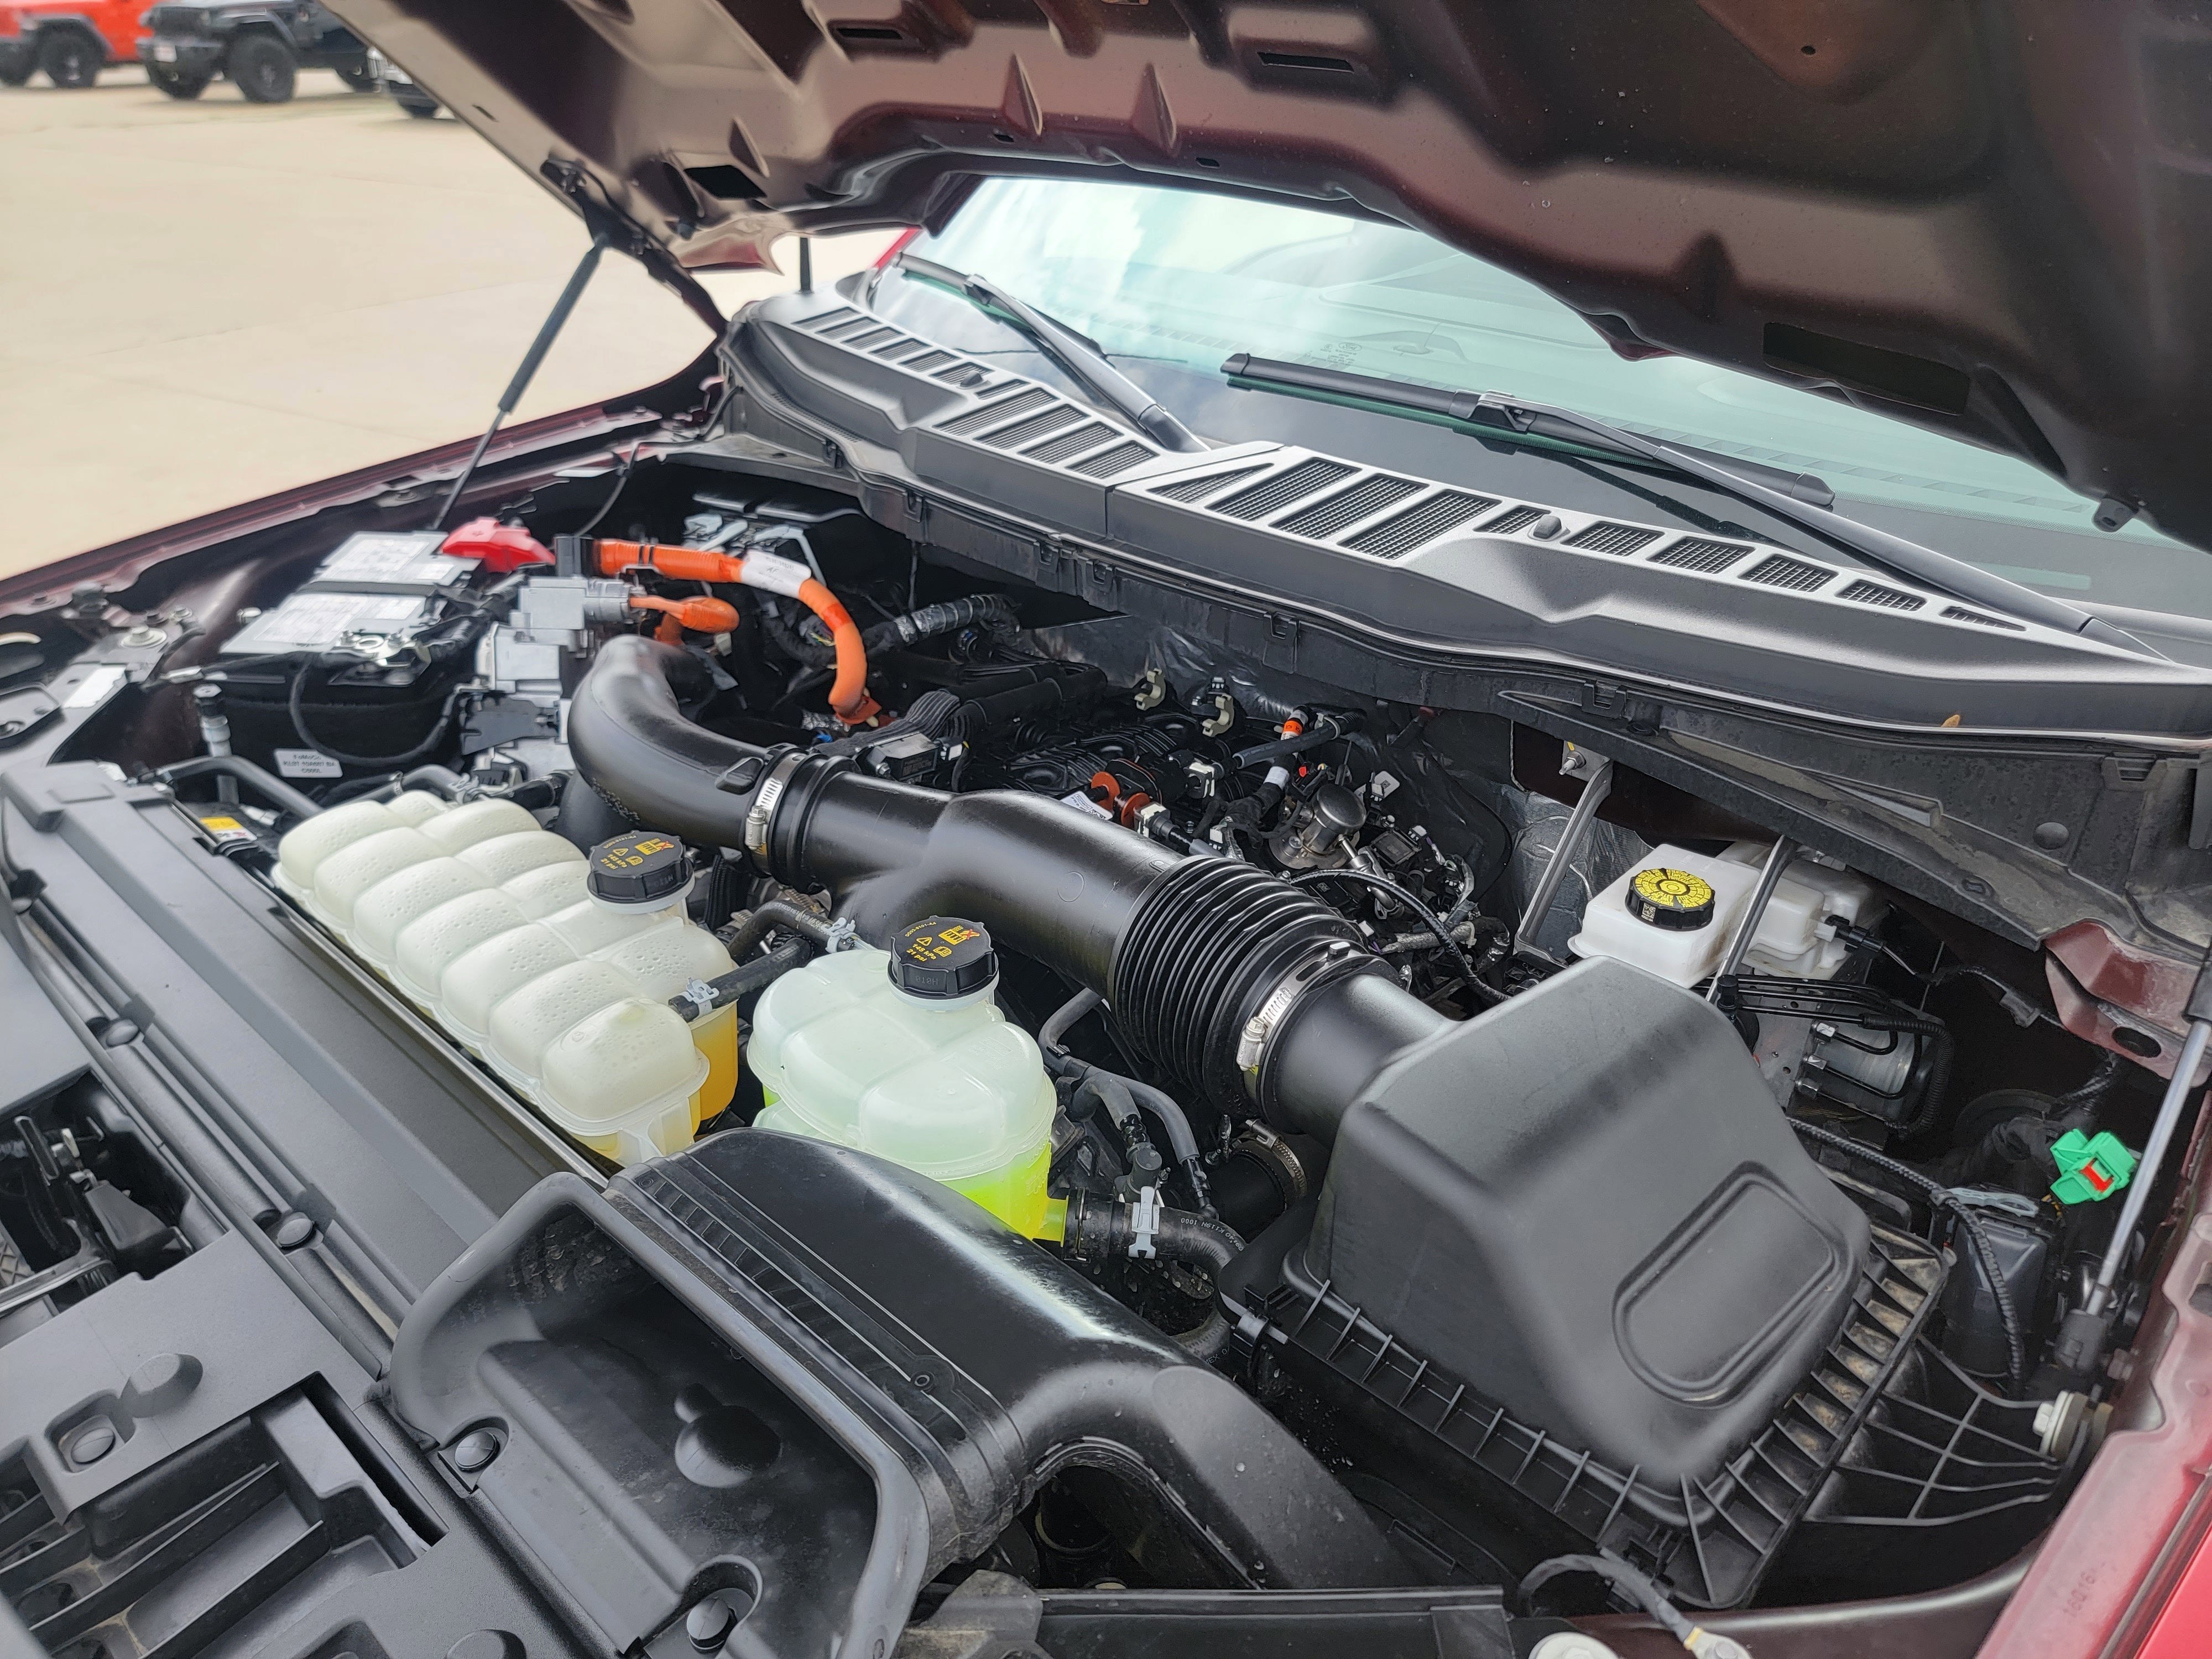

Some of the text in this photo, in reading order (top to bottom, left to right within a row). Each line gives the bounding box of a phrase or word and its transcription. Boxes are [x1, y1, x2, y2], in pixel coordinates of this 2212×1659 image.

[912, 943, 937, 960] 145 kPa
[1201, 1221, 1225, 1234] K119N
